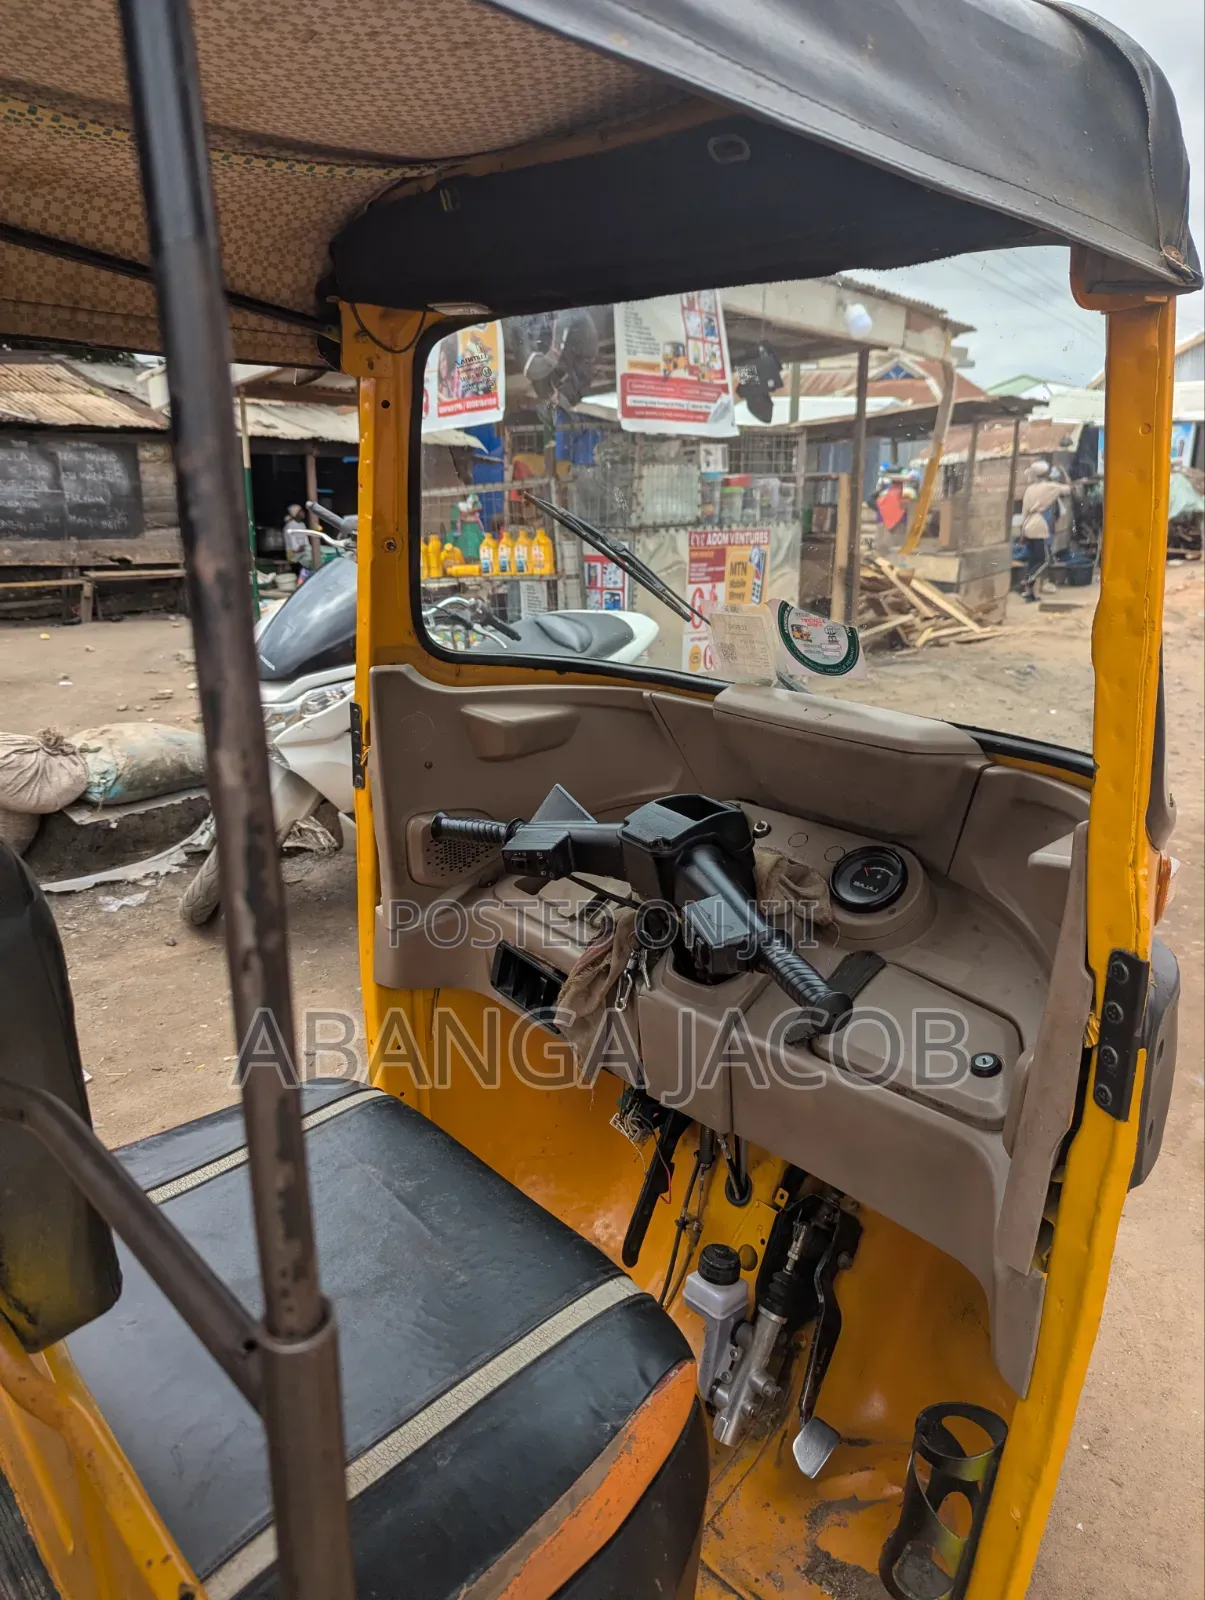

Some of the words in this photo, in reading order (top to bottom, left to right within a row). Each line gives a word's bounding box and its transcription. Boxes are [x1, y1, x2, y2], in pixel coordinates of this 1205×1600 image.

[707, 532, 729, 545] ADOM
[730, 531, 768, 545] VENTURES
[730, 562, 747, 576] MTN
[853, 880, 879, 893] BAJAJ
